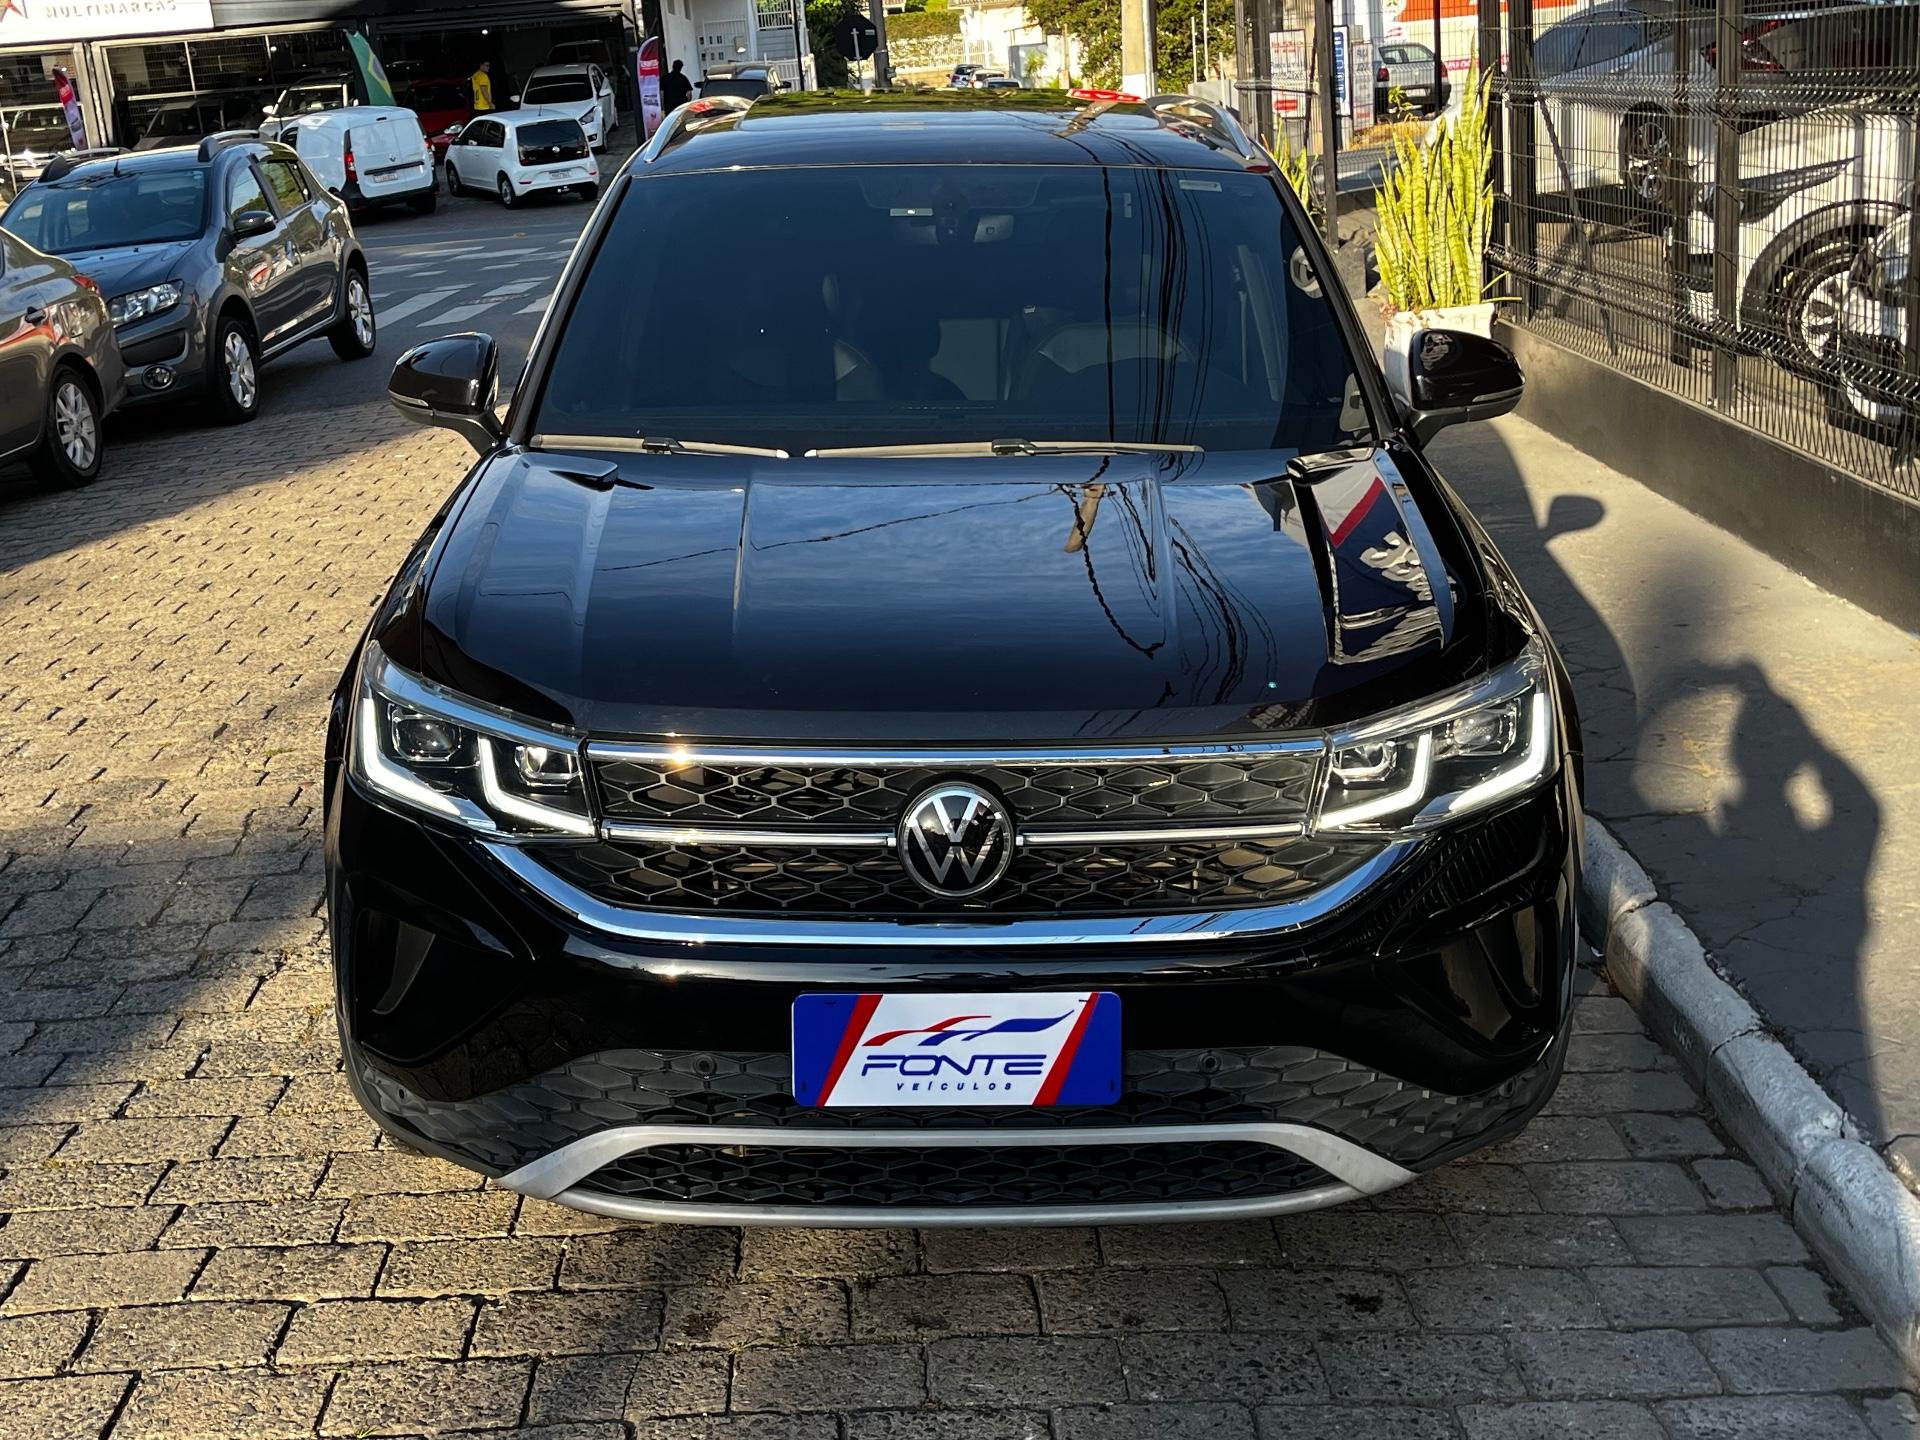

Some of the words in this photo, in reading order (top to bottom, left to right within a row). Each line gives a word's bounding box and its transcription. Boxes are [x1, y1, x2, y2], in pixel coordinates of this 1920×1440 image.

[46, 0, 177, 18] MULTIMARCAS
[861, 1054, 1047, 1077] FONTE
[896, 1082, 1013, 1091] VEÍCULOS
